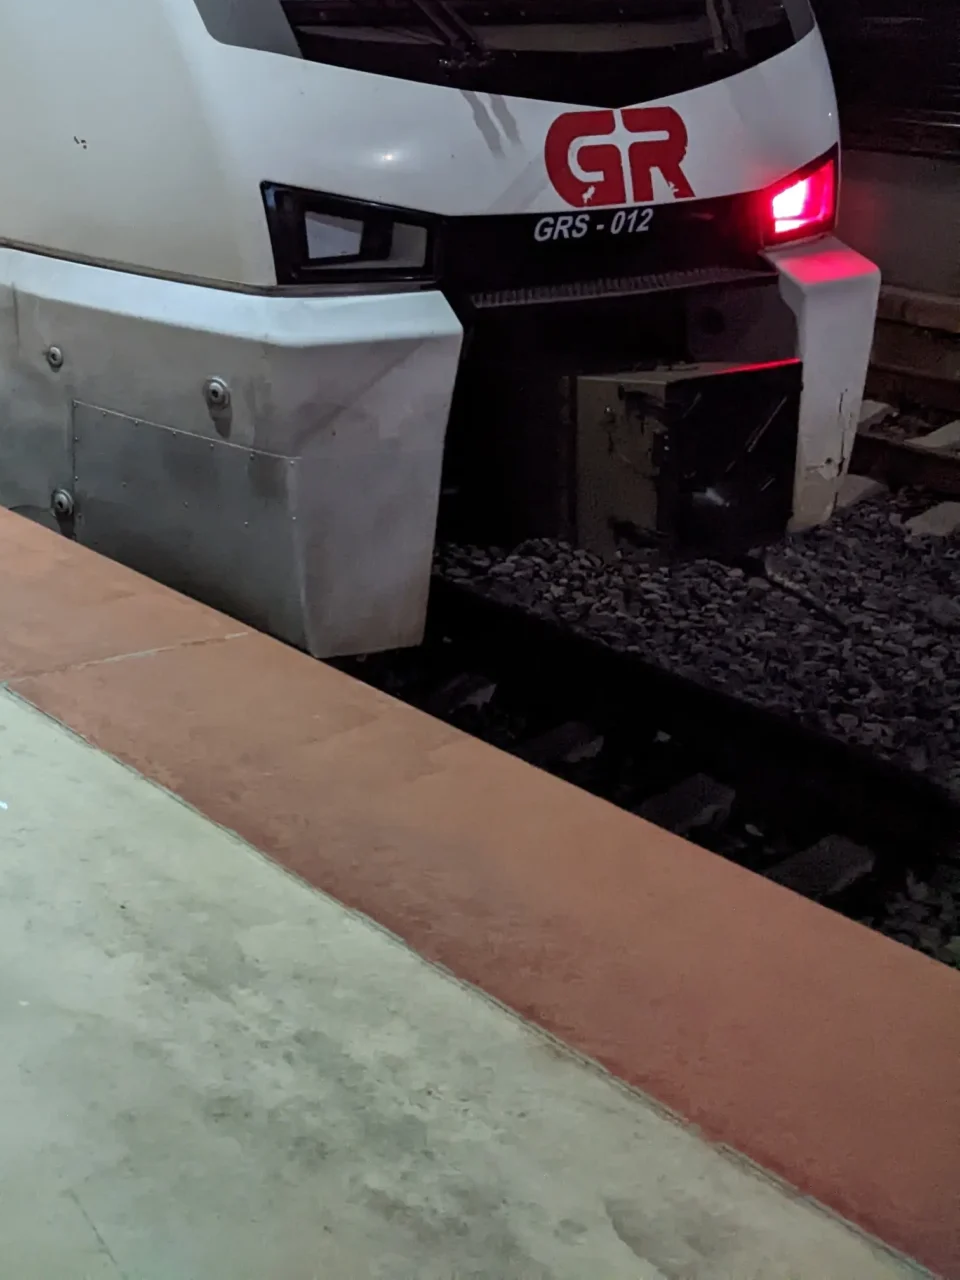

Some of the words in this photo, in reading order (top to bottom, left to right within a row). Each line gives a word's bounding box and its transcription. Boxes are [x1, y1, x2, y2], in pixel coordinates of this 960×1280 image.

[544, 106, 696, 208] GR
[533, 214, 590, 242] GRS
[610, 208, 654, 235] 012
